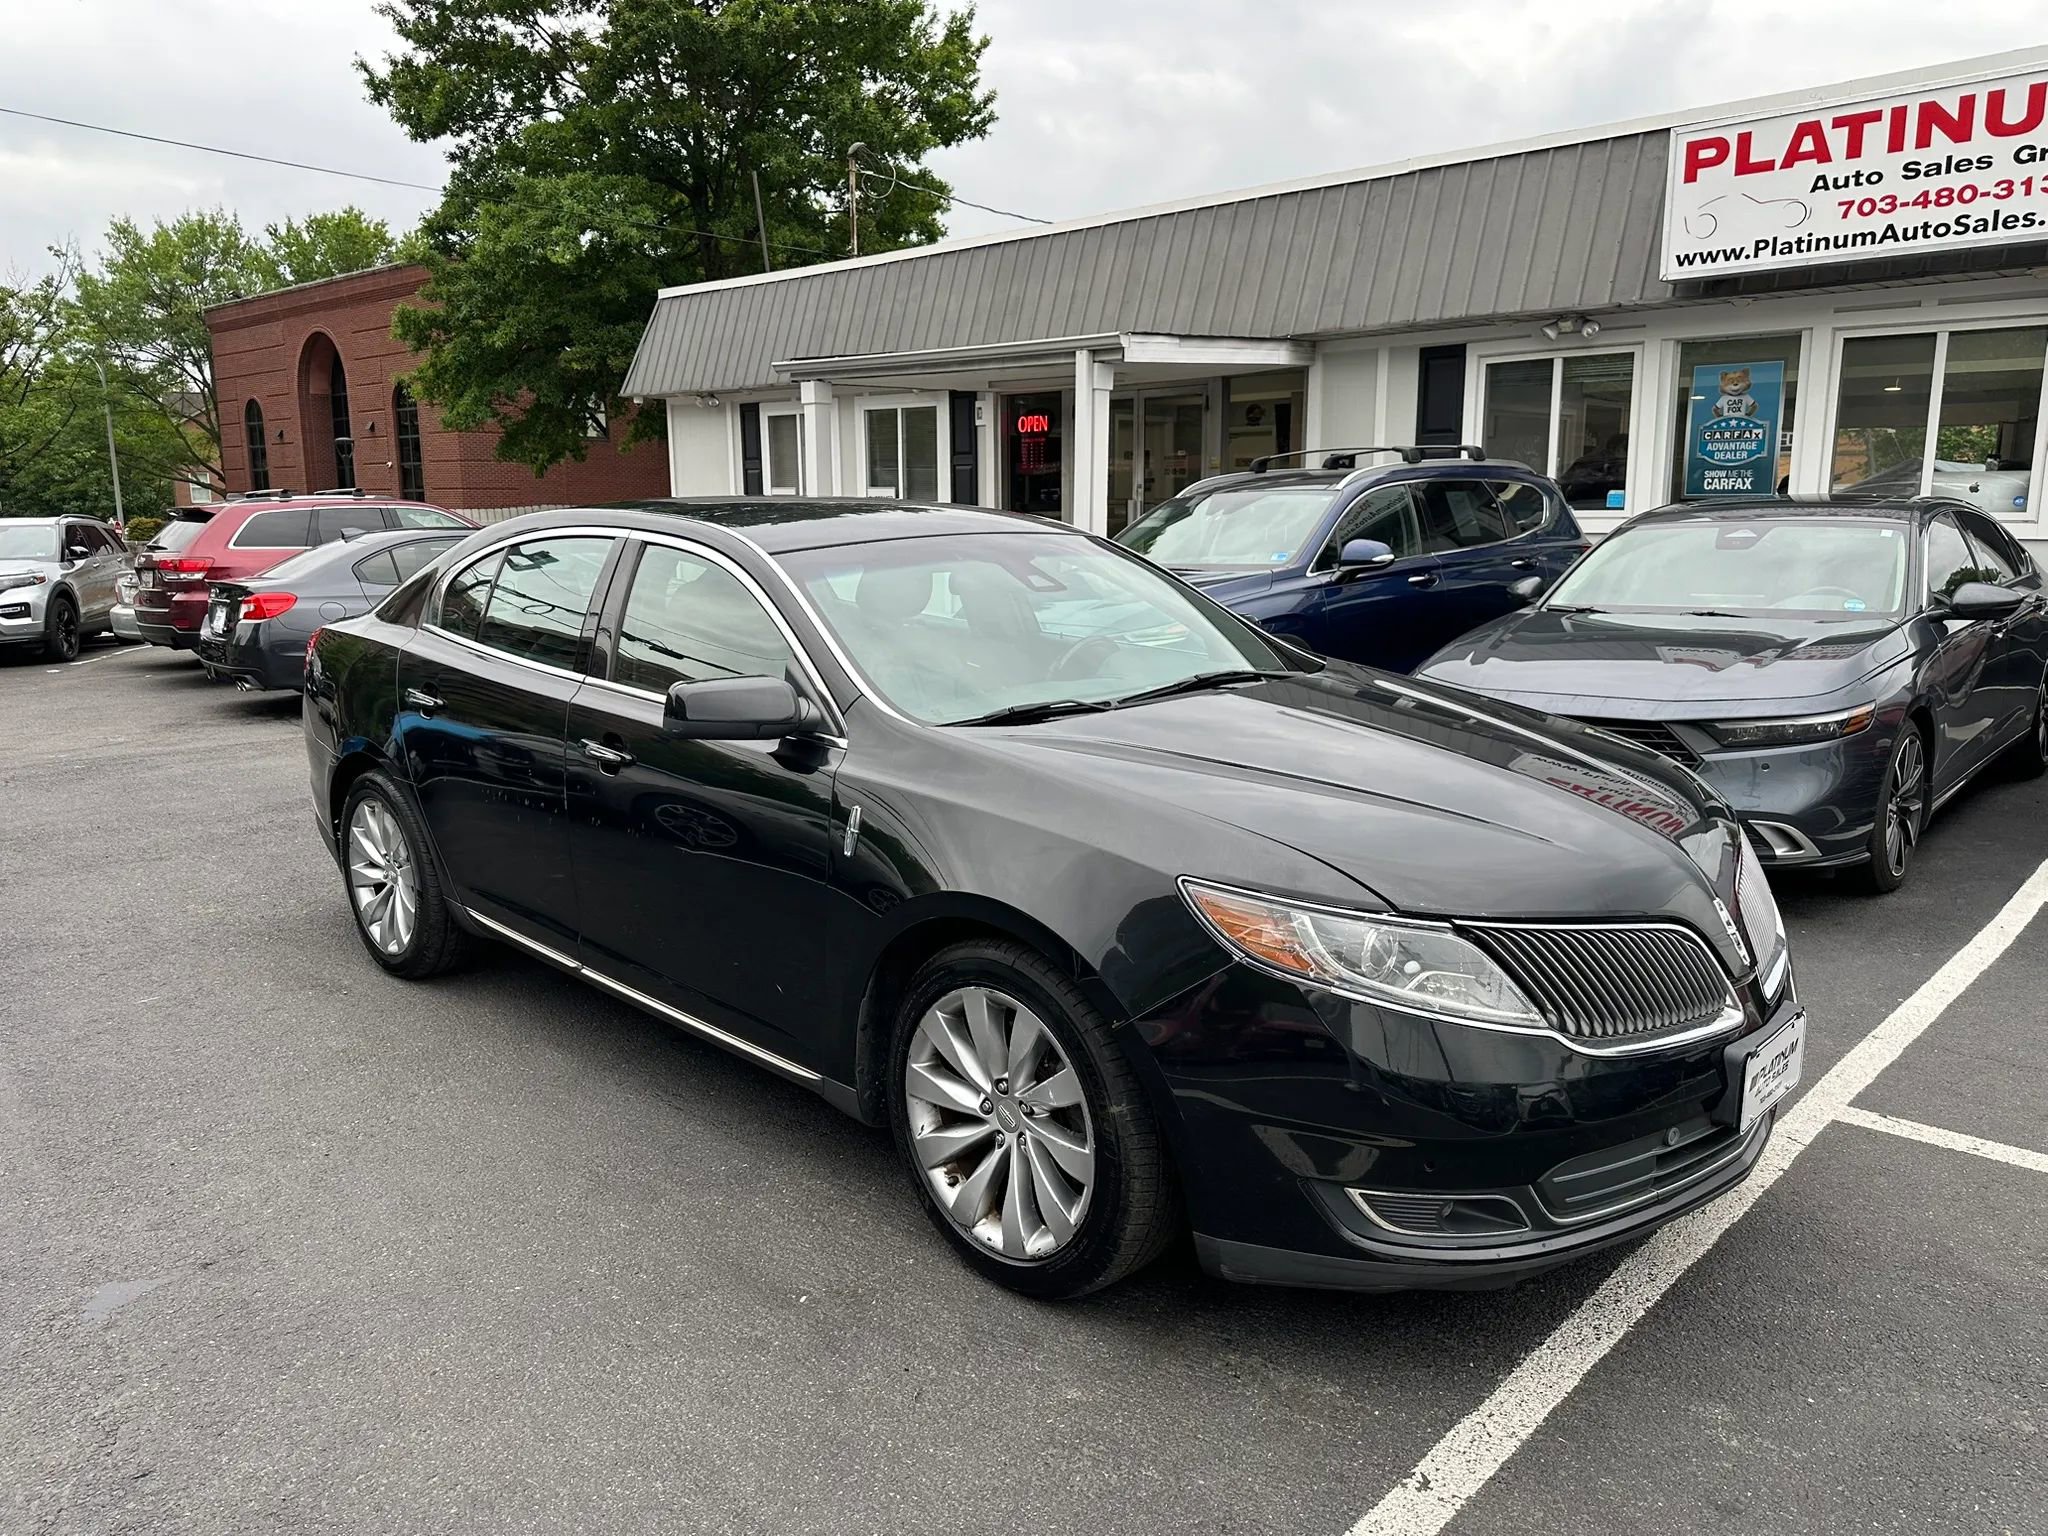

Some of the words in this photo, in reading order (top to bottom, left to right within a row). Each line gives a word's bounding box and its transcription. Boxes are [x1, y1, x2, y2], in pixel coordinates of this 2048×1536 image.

[1683, 82, 2048, 184] PLATINU
[1809, 168, 1884, 194] Auto
[1901, 155, 1994, 181] Sales
[1675, 208, 2047, 268] www.PlatinumAutoSales.
[1726, 398, 1744, 407] CAR
[1727, 406, 1742, 414] FOX
[1017, 415, 1048, 433] OPEN
[1703, 430, 1762, 440] CARFAX
[1706, 441, 1758, 451] ADVANTAGE
[1714, 451, 1748, 460] DEALER
[1704, 470, 1727, 478] SHOW
[1728, 470, 1738, 478] ME
[1740, 469, 1753, 477] THE
[1703, 478, 1753, 490] CARFAX
[1758, 1037, 1799, 1081] PLATINUM
